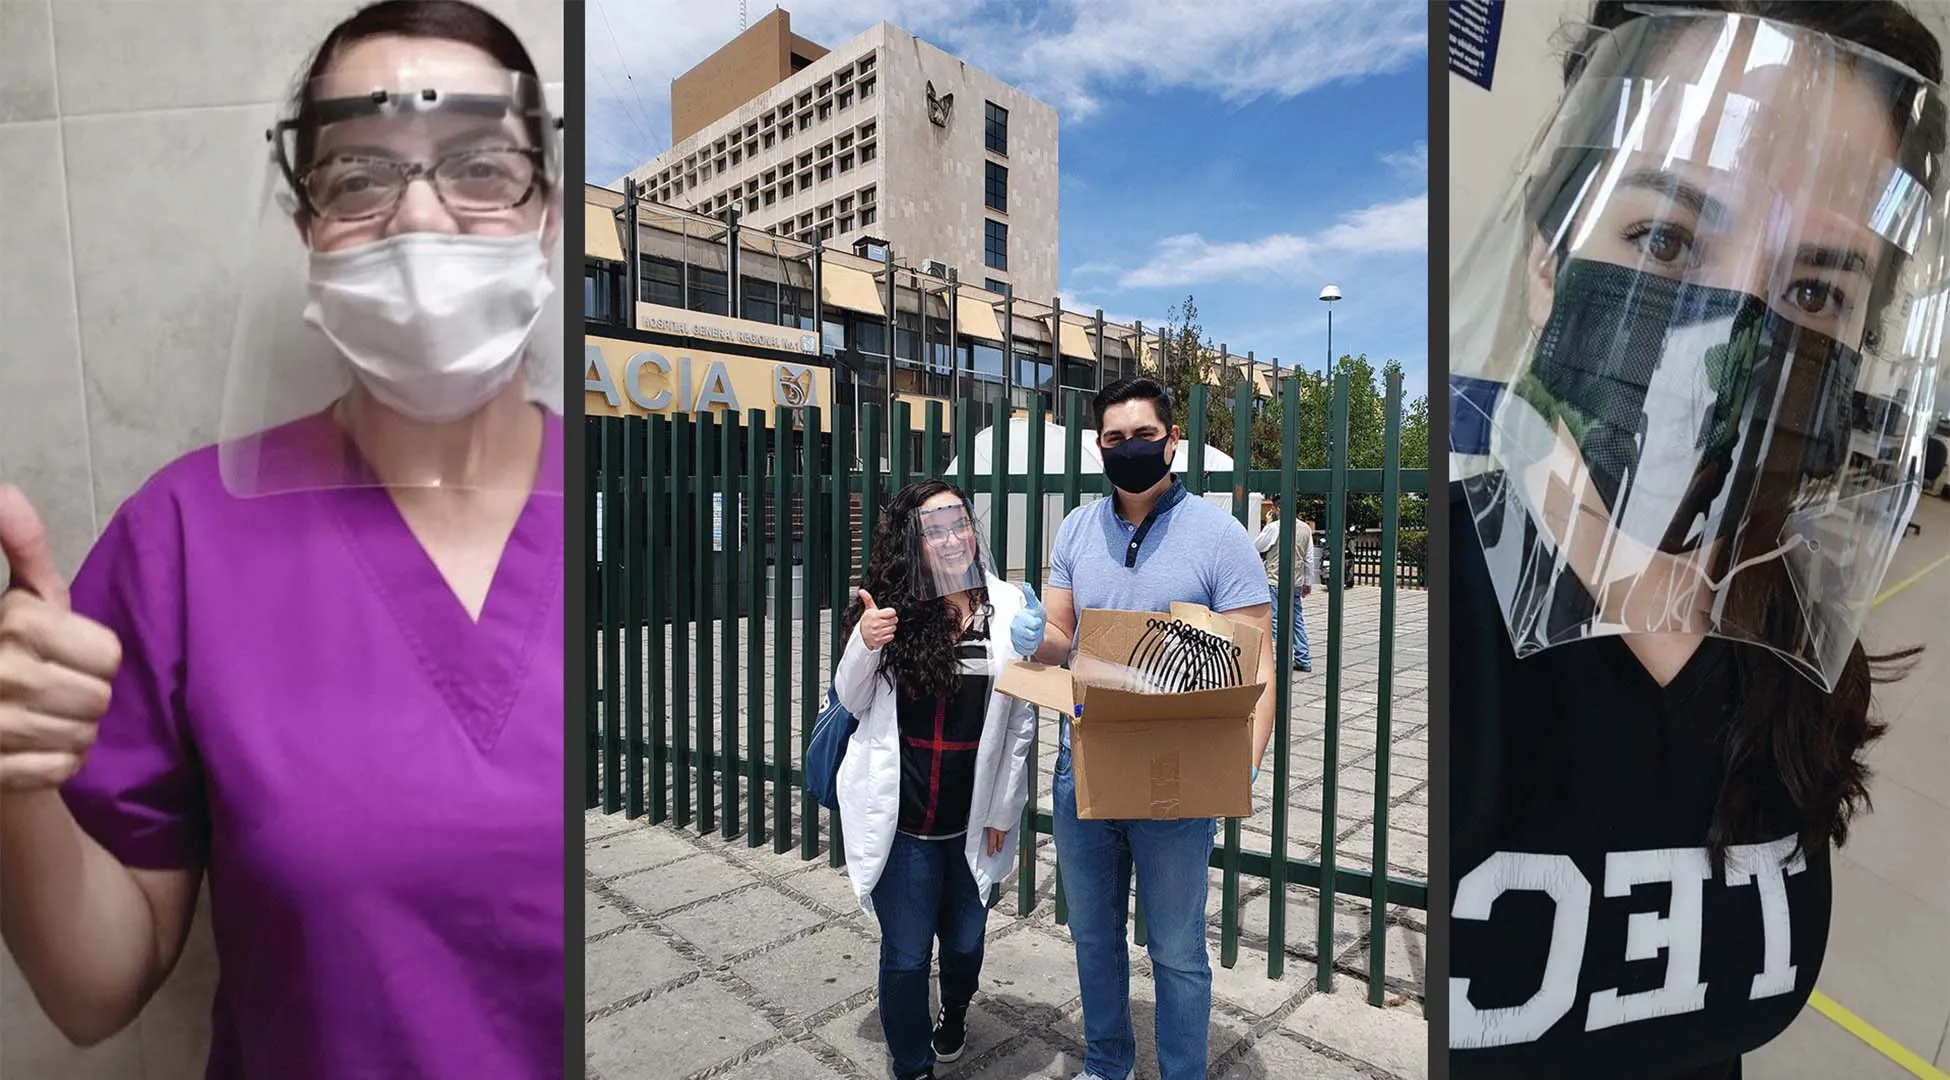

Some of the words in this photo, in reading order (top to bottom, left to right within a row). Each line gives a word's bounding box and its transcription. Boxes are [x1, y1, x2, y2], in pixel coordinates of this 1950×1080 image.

[642, 316, 690, 335] HOSPITAL
[692, 325, 734, 342] GENERAL
[737, 331, 780, 348] REGIONAL
